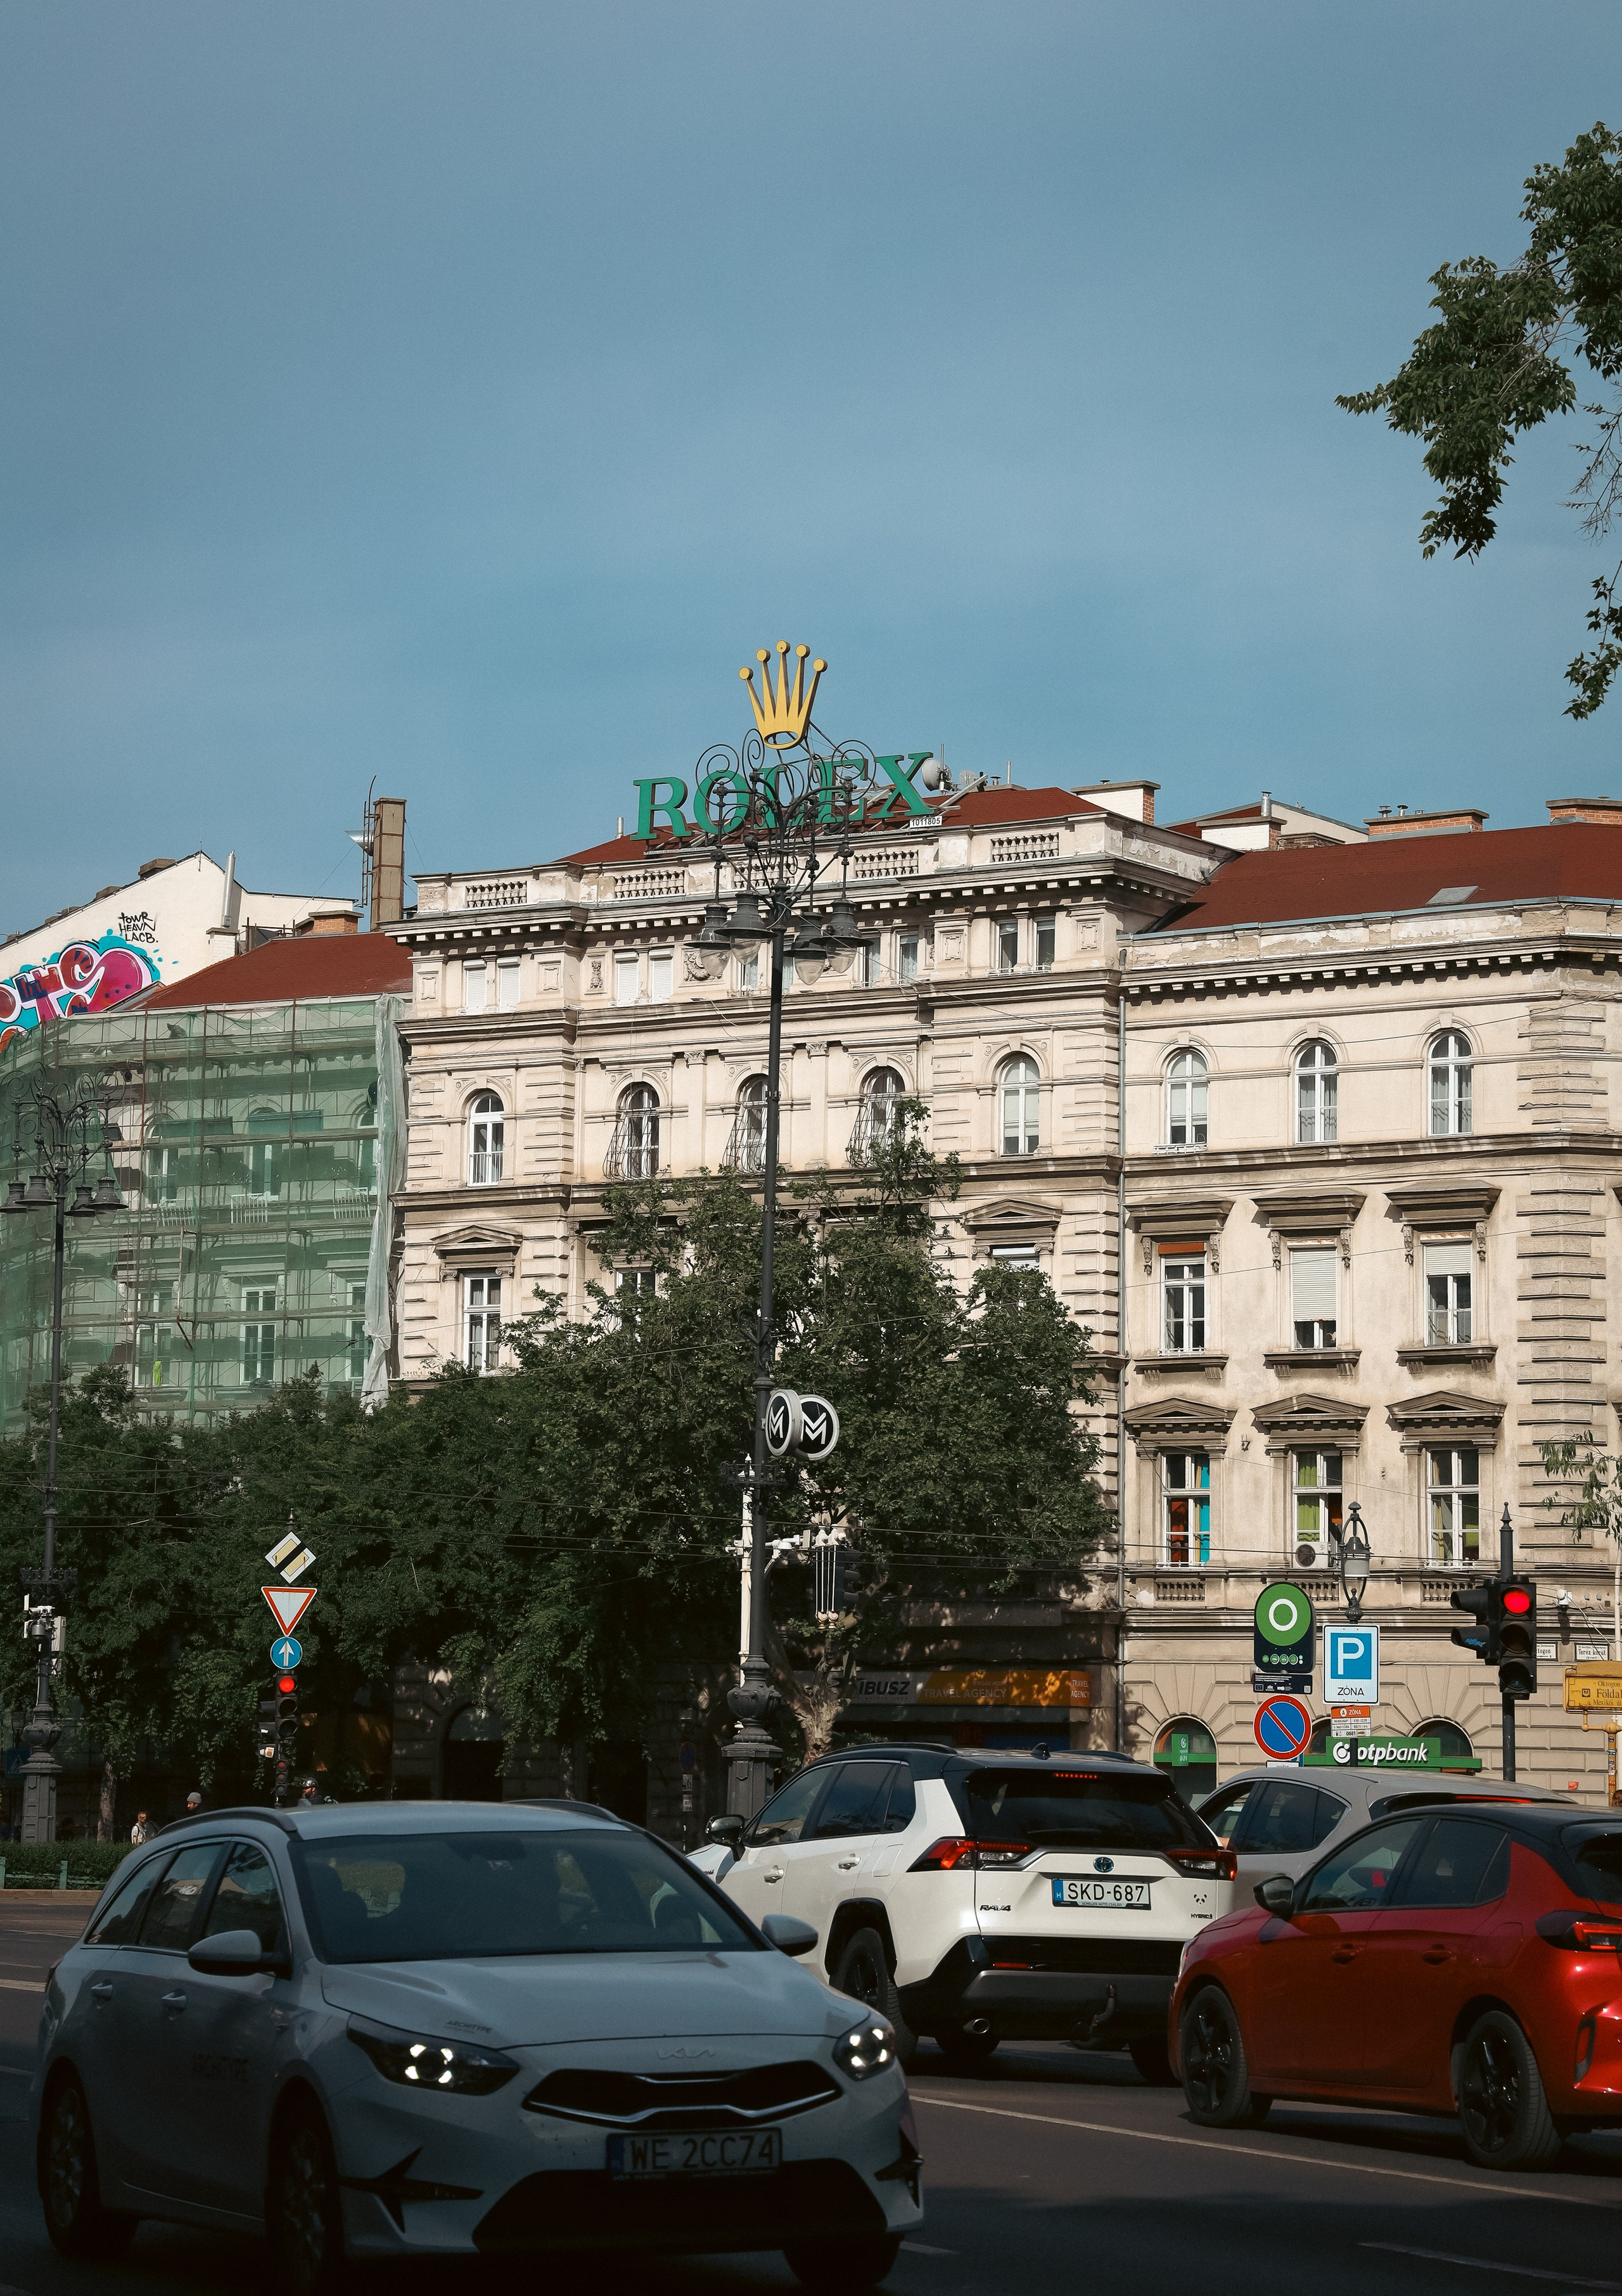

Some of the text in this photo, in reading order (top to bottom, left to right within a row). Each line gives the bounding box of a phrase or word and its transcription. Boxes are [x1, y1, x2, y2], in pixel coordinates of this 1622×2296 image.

[630, 752, 935, 841] ROLEX
[911, 818, 941, 826] 1011805
[1338, 1637, 1365, 1675] P
[858, 1681, 910, 1695] IBUSZ
[1072, 1679, 1089, 1688] TRAVEL
[1597, 1680, 1621, 1688] Oktogon
[923, 1688, 1007, 1698] TRAVEL AGENCY
[1071, 1690, 1090, 1698] AGENCY
[1338, 1686, 1364, 1696] ZÓNA
[1358, 1742, 1428, 1766] otpbank
[1068, 1883, 1144, 1902] SKD-687
[630, 2135, 774, 2171] WE 2CC74
